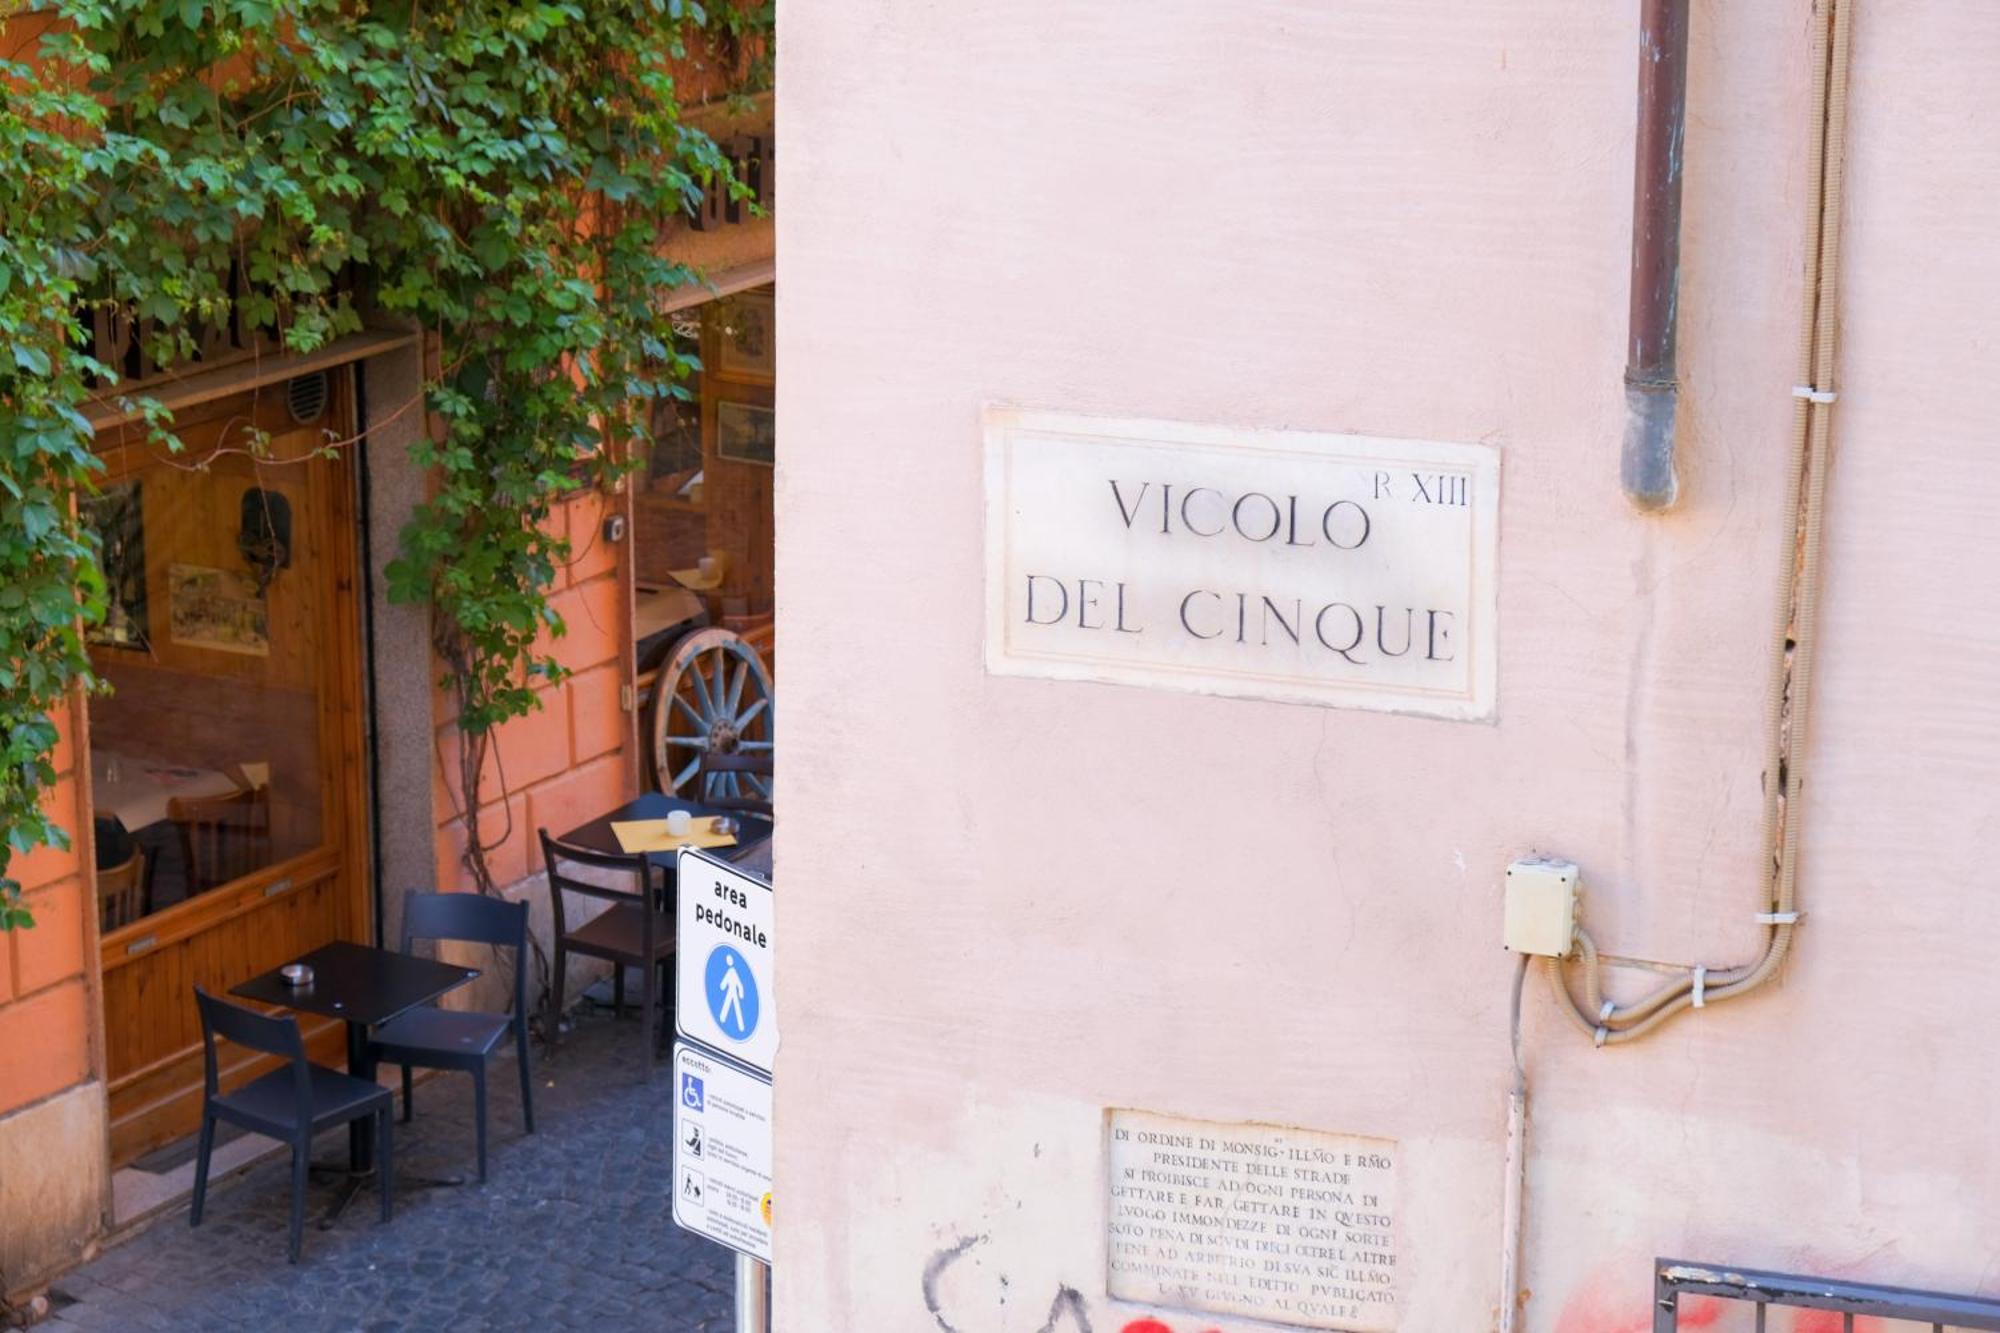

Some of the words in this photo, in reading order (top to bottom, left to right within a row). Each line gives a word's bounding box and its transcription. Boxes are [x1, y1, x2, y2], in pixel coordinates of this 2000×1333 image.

[1374, 470, 1393, 499] R
[1412, 472, 1467, 506] XIII
[1108, 480, 1371, 549] VICOLO
[1024, 575, 1144, 633] DEL
[1179, 590, 1455, 665] CINQUE
[714, 881, 747, 909] area
[696, 903, 767, 949] pedonale
[1115, 1129, 1129, 1141] DI
[1138, 1132, 1193, 1148] ORDINE
[1200, 1138, 1215, 1151] DI
[1344, 1154, 1351, 1166] E
[1154, 1152, 1239, 1173] PRESIDENTE
[1246, 1163, 1288, 1178] DELLE
[1294, 1168, 1351, 1184] STRADE
[1125, 1168, 1135, 1180] SI
[1142, 1169, 1209, 1189] PROIBISCE
[1218, 1181, 1240, 1192] AD
[1246, 1182, 1282, 1197] OGNI
[1291, 1187, 1354, 1205] PERSONA
[1363, 1195, 1378, 1207] DI
[1111, 1185, 1175, 1203] GETTARE
[1180, 1193, 1188, 1205] E
[1195, 1195, 1223, 1208] FAR
[1234, 1200, 1300, 1218] GETTARE
[1310, 1208, 1327, 1220] IN
[1335, 1211, 1392, 1228] QVESTO
[1151, 1228, 1185, 1242] PENA
[1190, 1232, 1203, 1245] DI
[1354, 1251, 1397, 1266] ALTRE
[1173, 1211, 1267, 1233] IMMONDEZZE
[1277, 1223, 1291, 1236] DI
[1299, 1226, 1337, 1241] OGNI
[1345, 1231, 1391, 1247] SORTE
[1158, 1247, 1178, 1259] AD
[1264, 1260, 1281, 1273] DI
[1285, 1263, 1311, 1276] SVA
[1311, 1284, 1394, 1303] PVBLICATO
